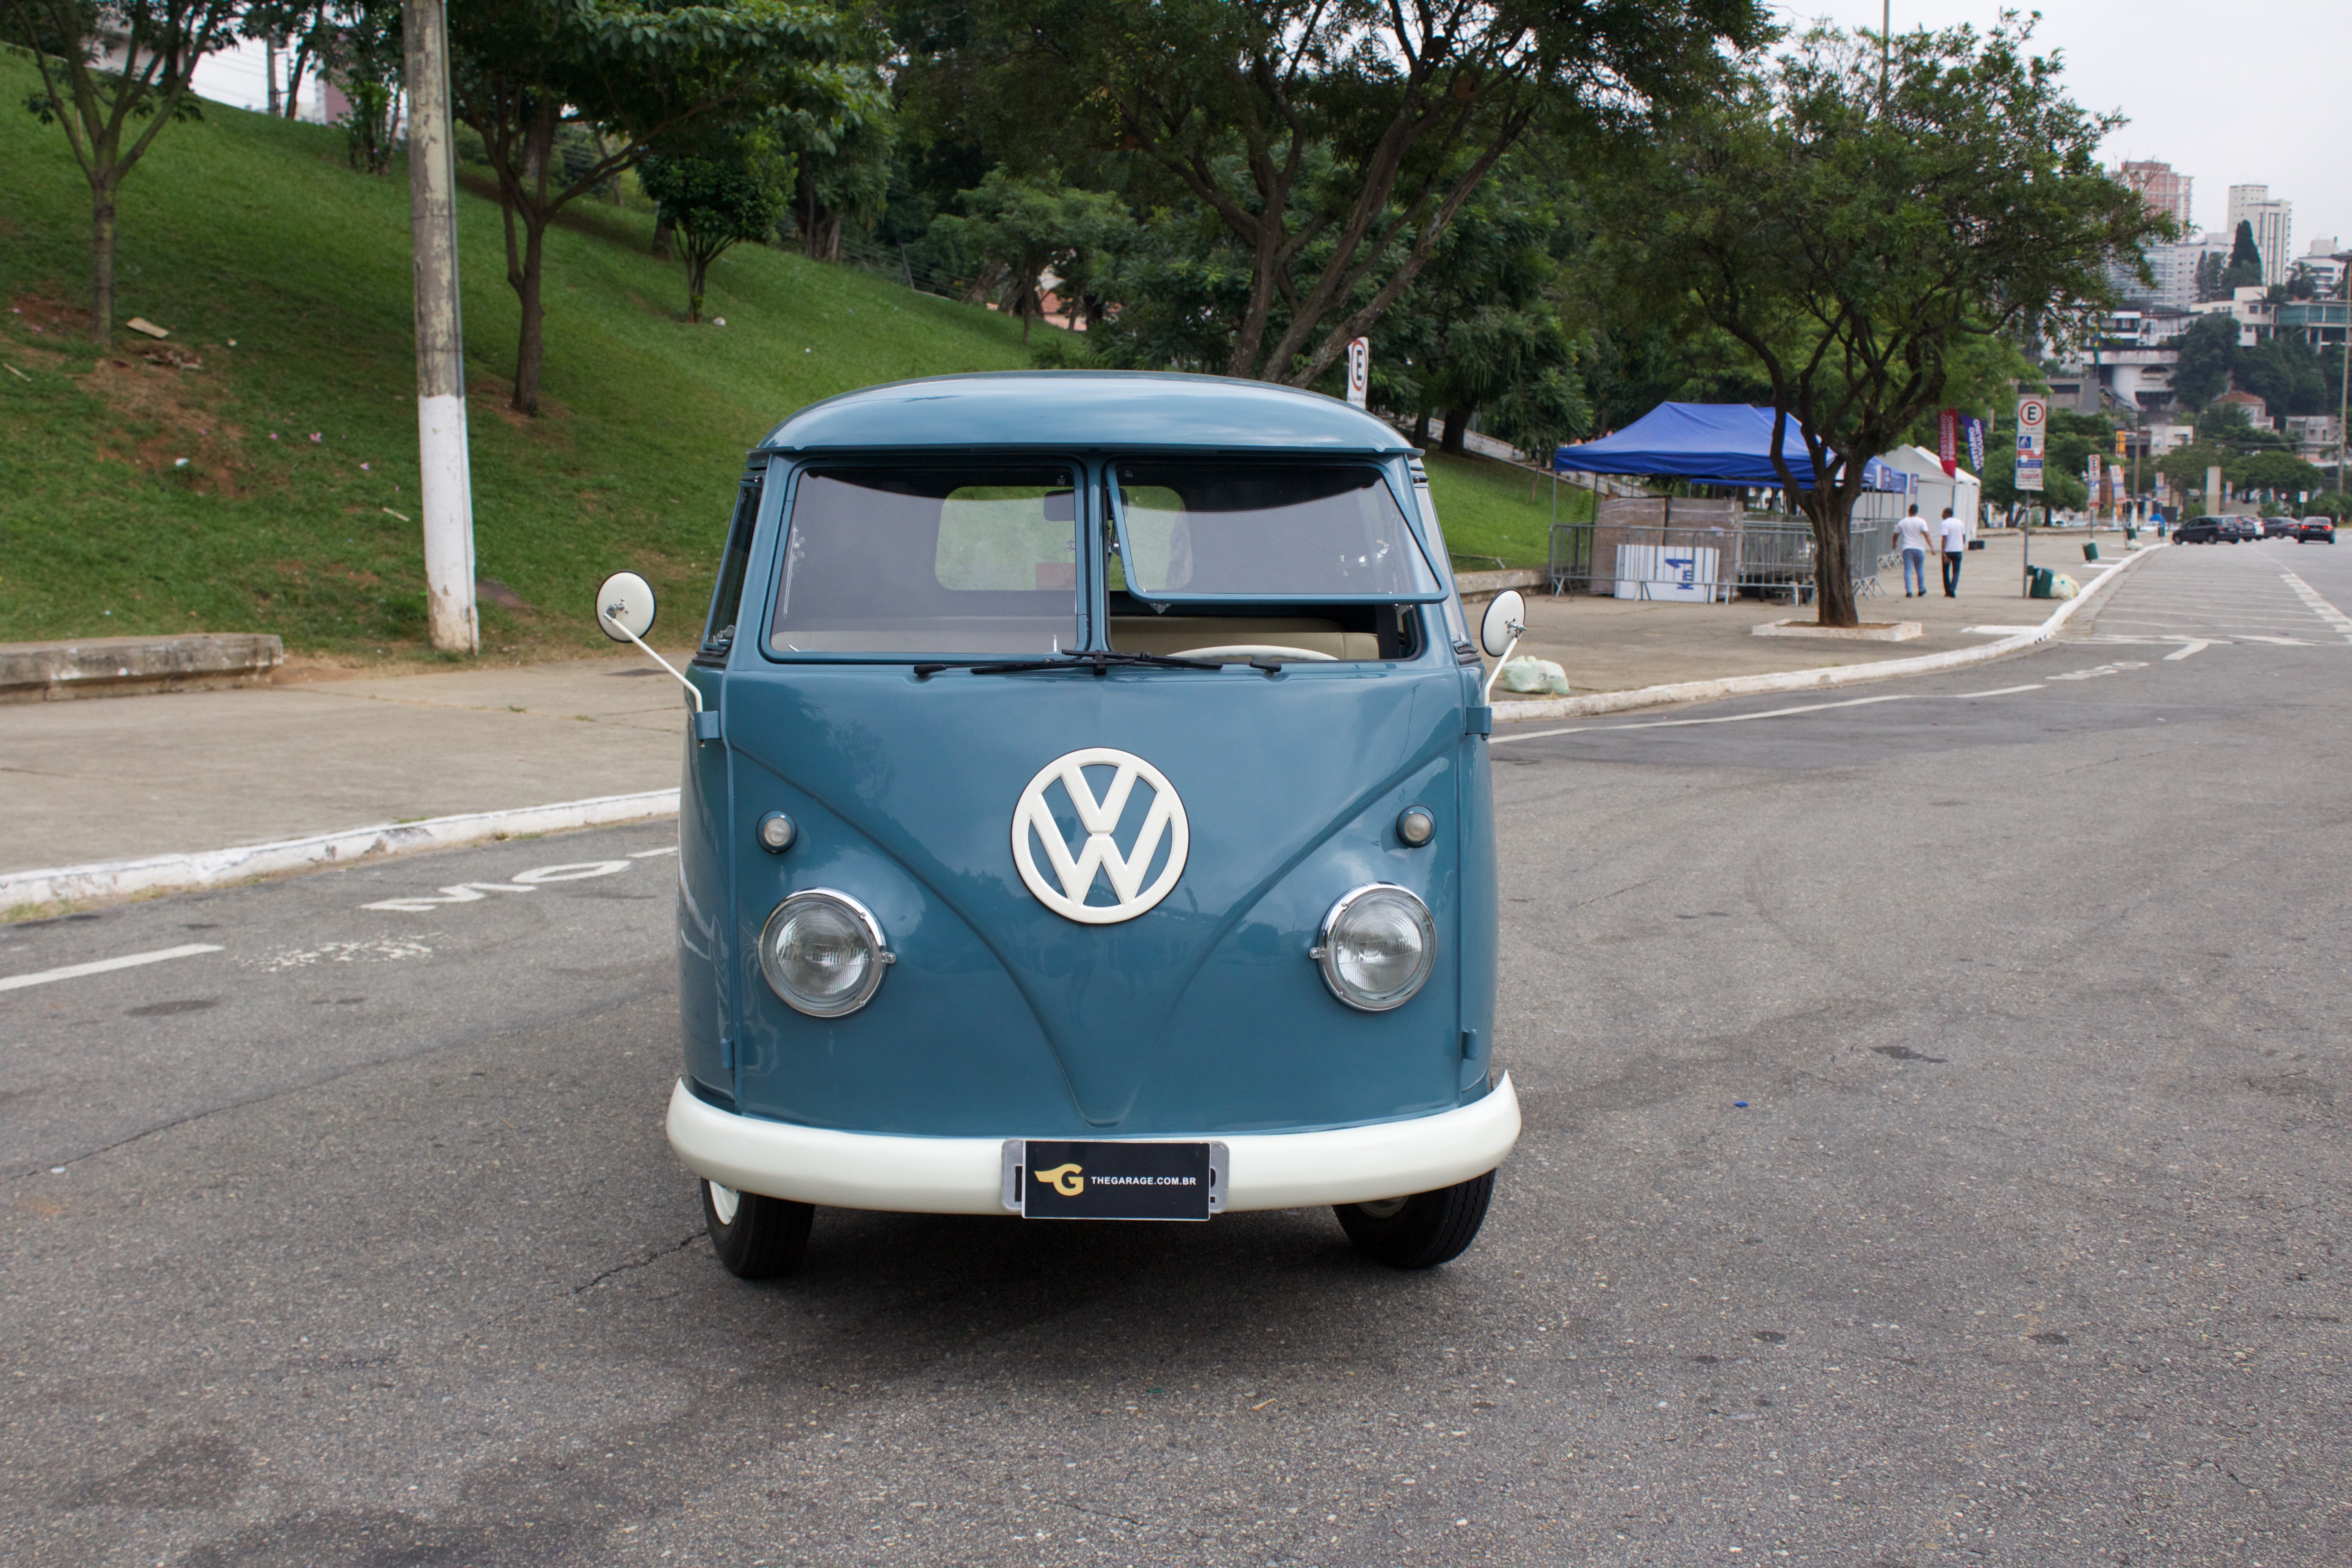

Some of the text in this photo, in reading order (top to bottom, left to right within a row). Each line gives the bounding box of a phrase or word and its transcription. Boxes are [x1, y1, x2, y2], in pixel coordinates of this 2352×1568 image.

[1357, 349, 1362, 381] E
[2028, 407, 2036, 420] E
[1665, 559, 1694, 568] 1
[1091, 1176, 1196, 1186] THEGARAGE.COM.BR
